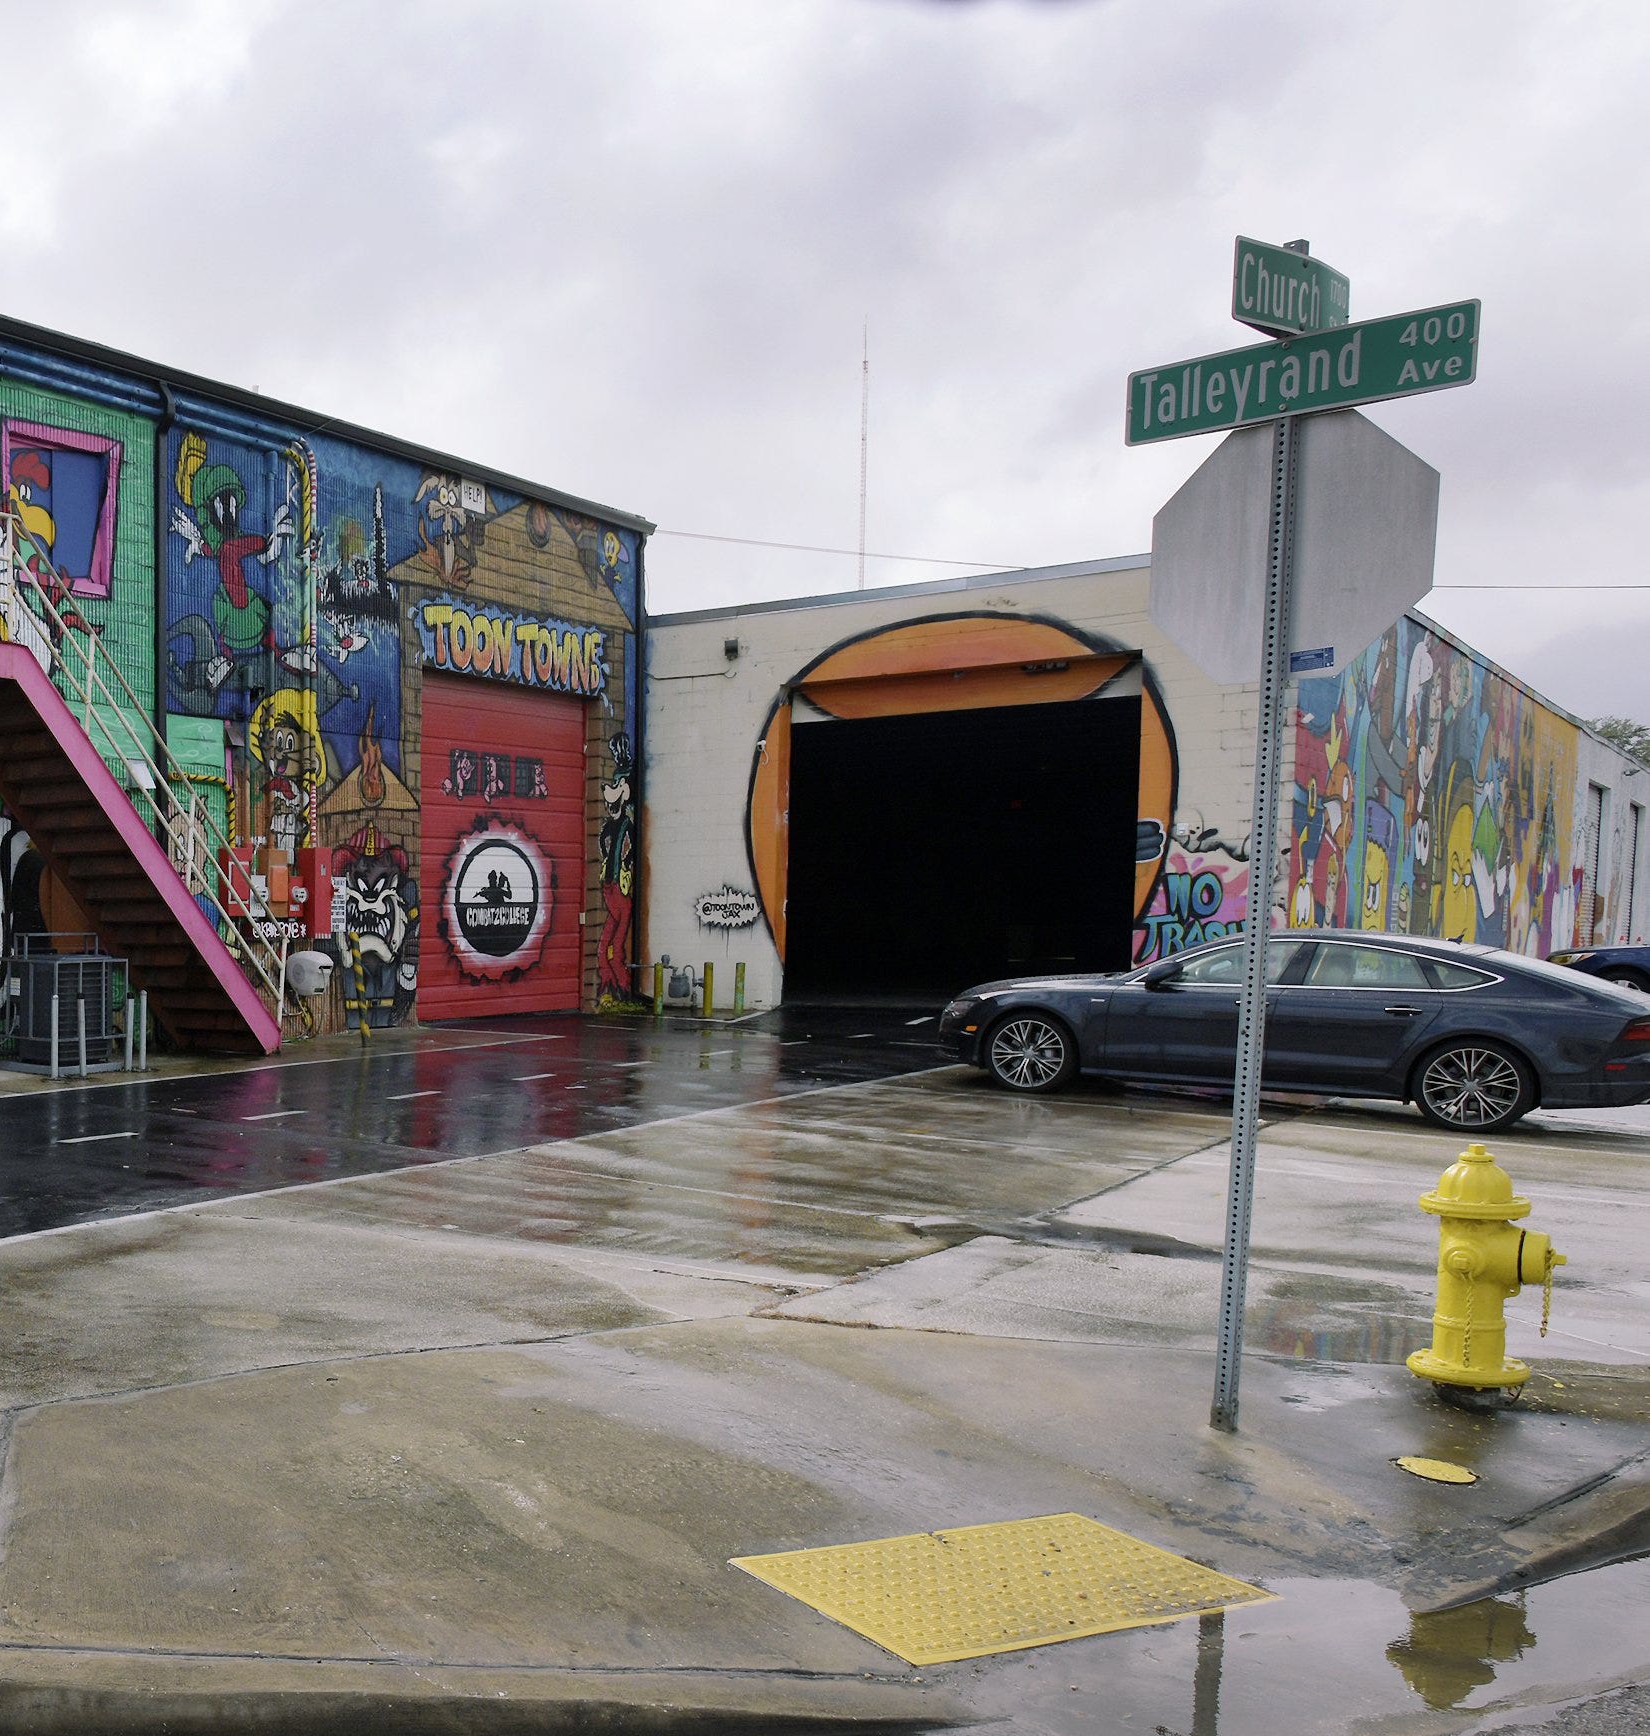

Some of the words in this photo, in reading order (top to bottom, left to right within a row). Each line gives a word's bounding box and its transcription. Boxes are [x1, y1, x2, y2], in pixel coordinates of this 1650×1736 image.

[1240, 252, 1320, 329] Church
[1399, 312, 1466, 347] 400
[1139, 328, 1363, 430] Talleyrand
[1397, 354, 1463, 386] Ave
[463, 485, 482, 504] HELP!
[702, 902, 754, 915] @TOONTOWN
[1165, 871, 1223, 921] NO
[722, 910, 741, 919] JAX
